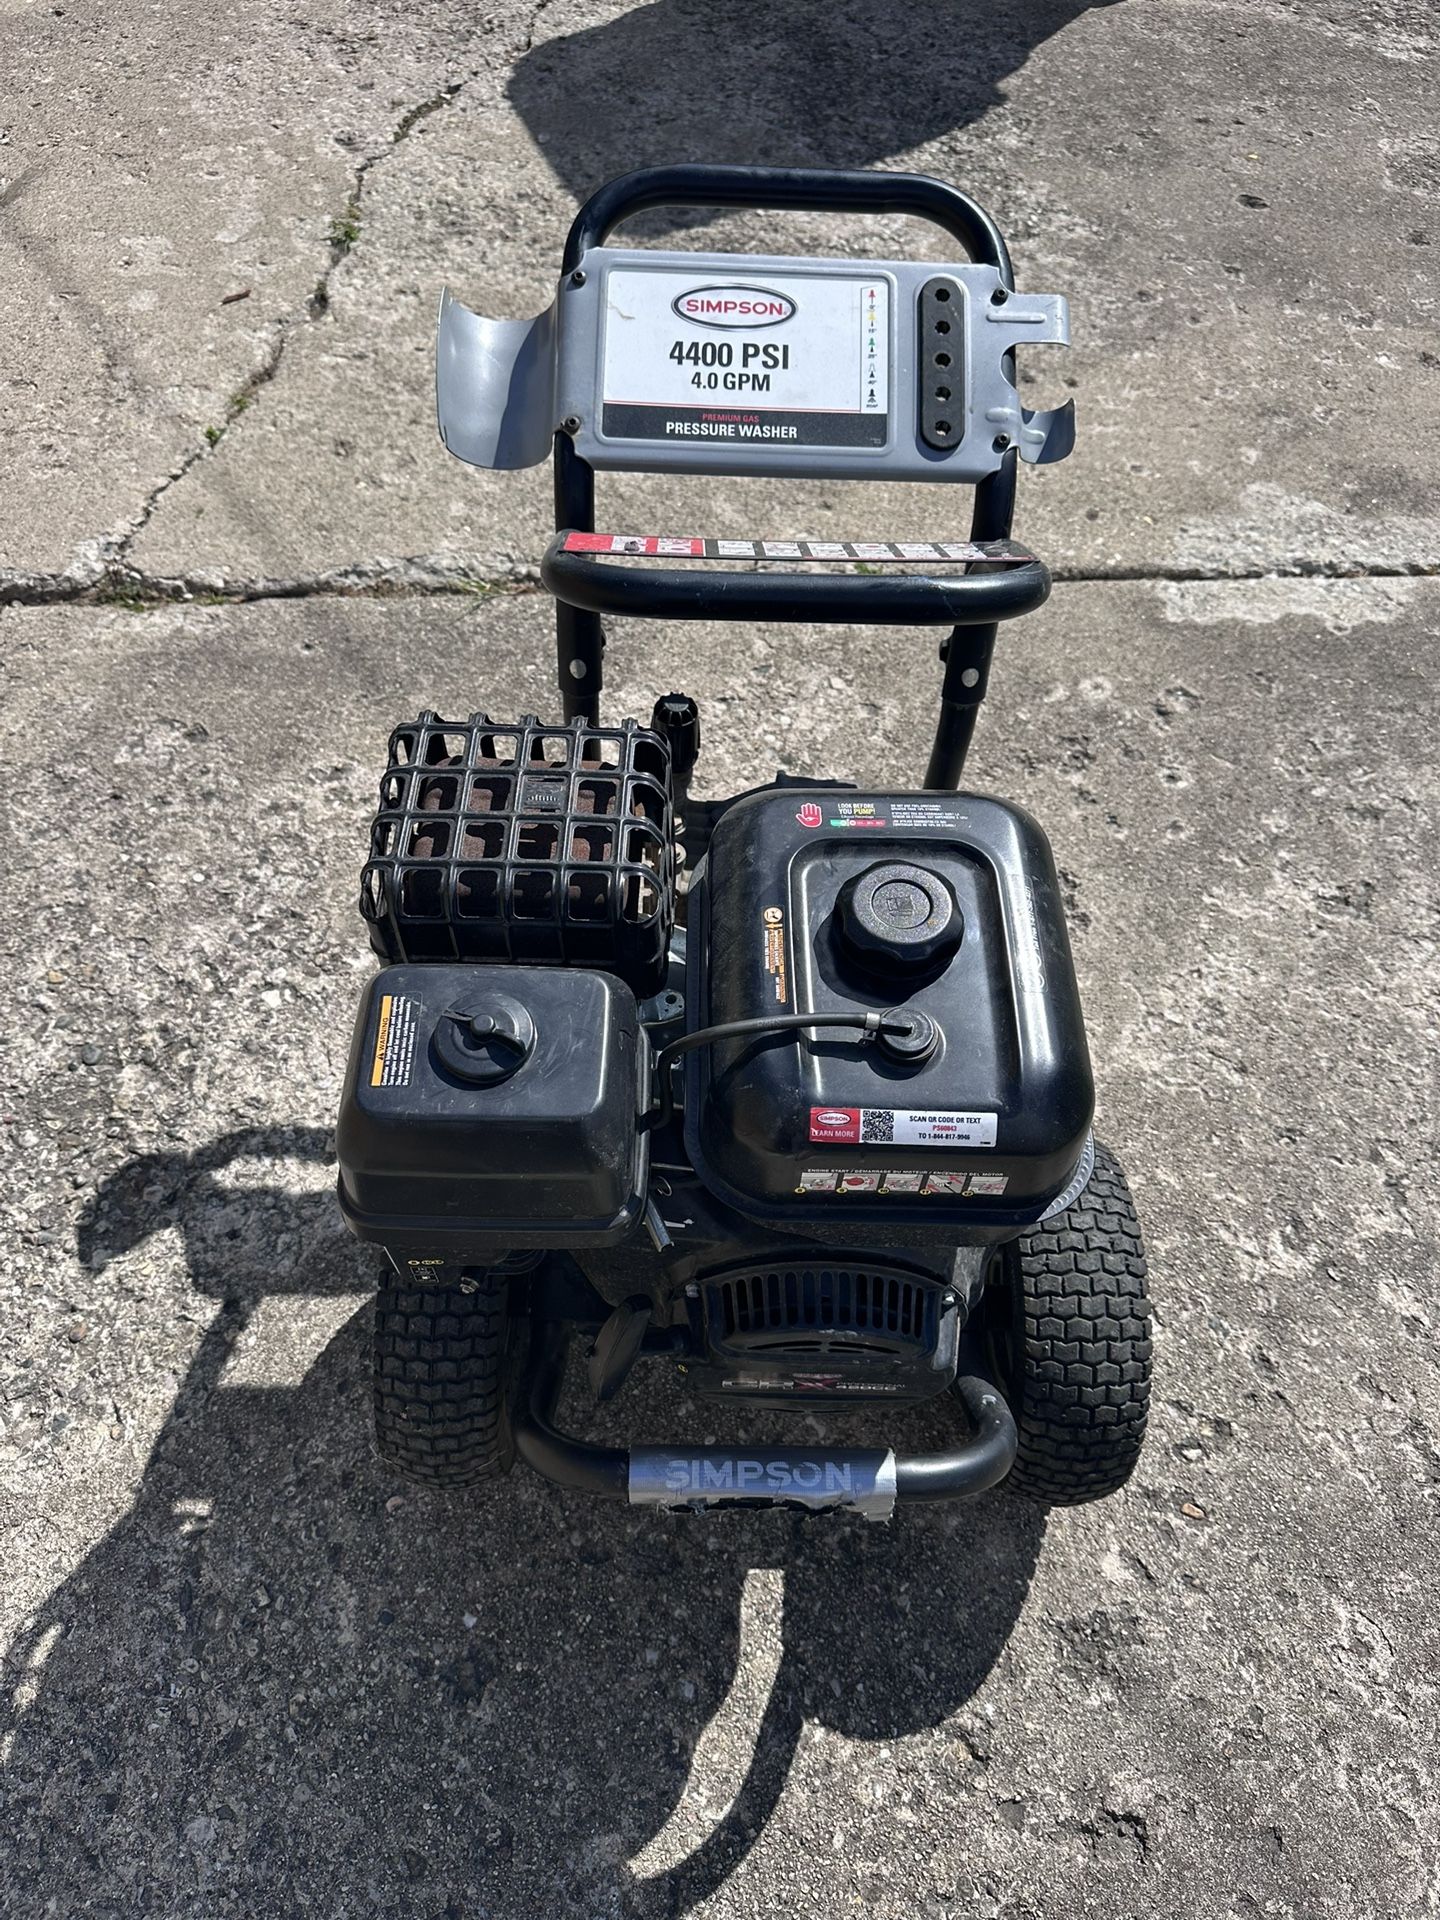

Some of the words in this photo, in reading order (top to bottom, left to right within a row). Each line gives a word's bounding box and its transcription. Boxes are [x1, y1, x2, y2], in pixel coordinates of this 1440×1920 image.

[686, 299, 782, 316] SIMPSON
[669, 341, 733, 368] 4400
[742, 342, 789, 370] PSI
[691, 372, 718, 390] 4.0
[723, 372, 770, 392] GPM
[702, 413, 741, 422] PREMIUM
[742, 414, 760, 423] GAS
[666, 422, 736, 436] PRESSURE
[738, 424, 798, 438] WASHER
[378, 1017, 388, 1051] WARNING
[665, 1460, 850, 1490] SIMPSON
